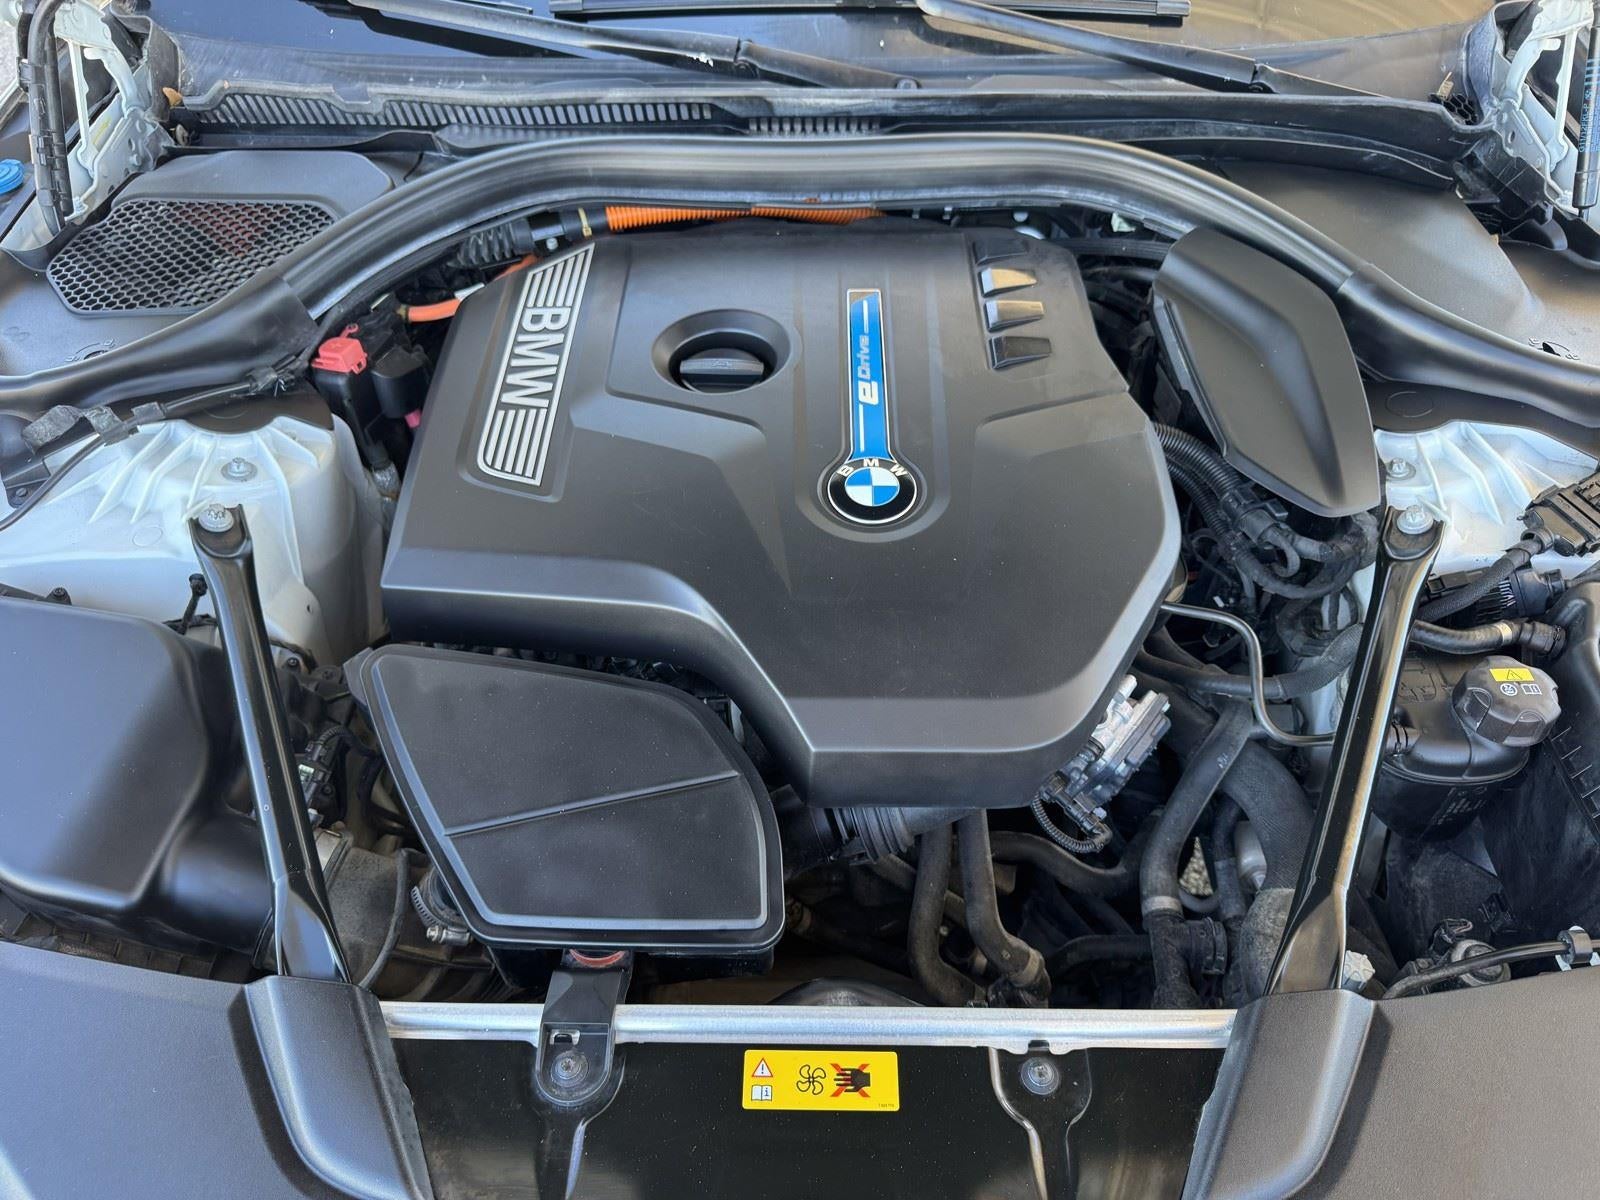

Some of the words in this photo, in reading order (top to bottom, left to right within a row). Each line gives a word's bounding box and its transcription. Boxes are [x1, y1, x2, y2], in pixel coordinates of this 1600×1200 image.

[501, 307, 571, 408] BMW
[857, 334, 879, 406] eDrive
[836, 457, 908, 477] BMW
